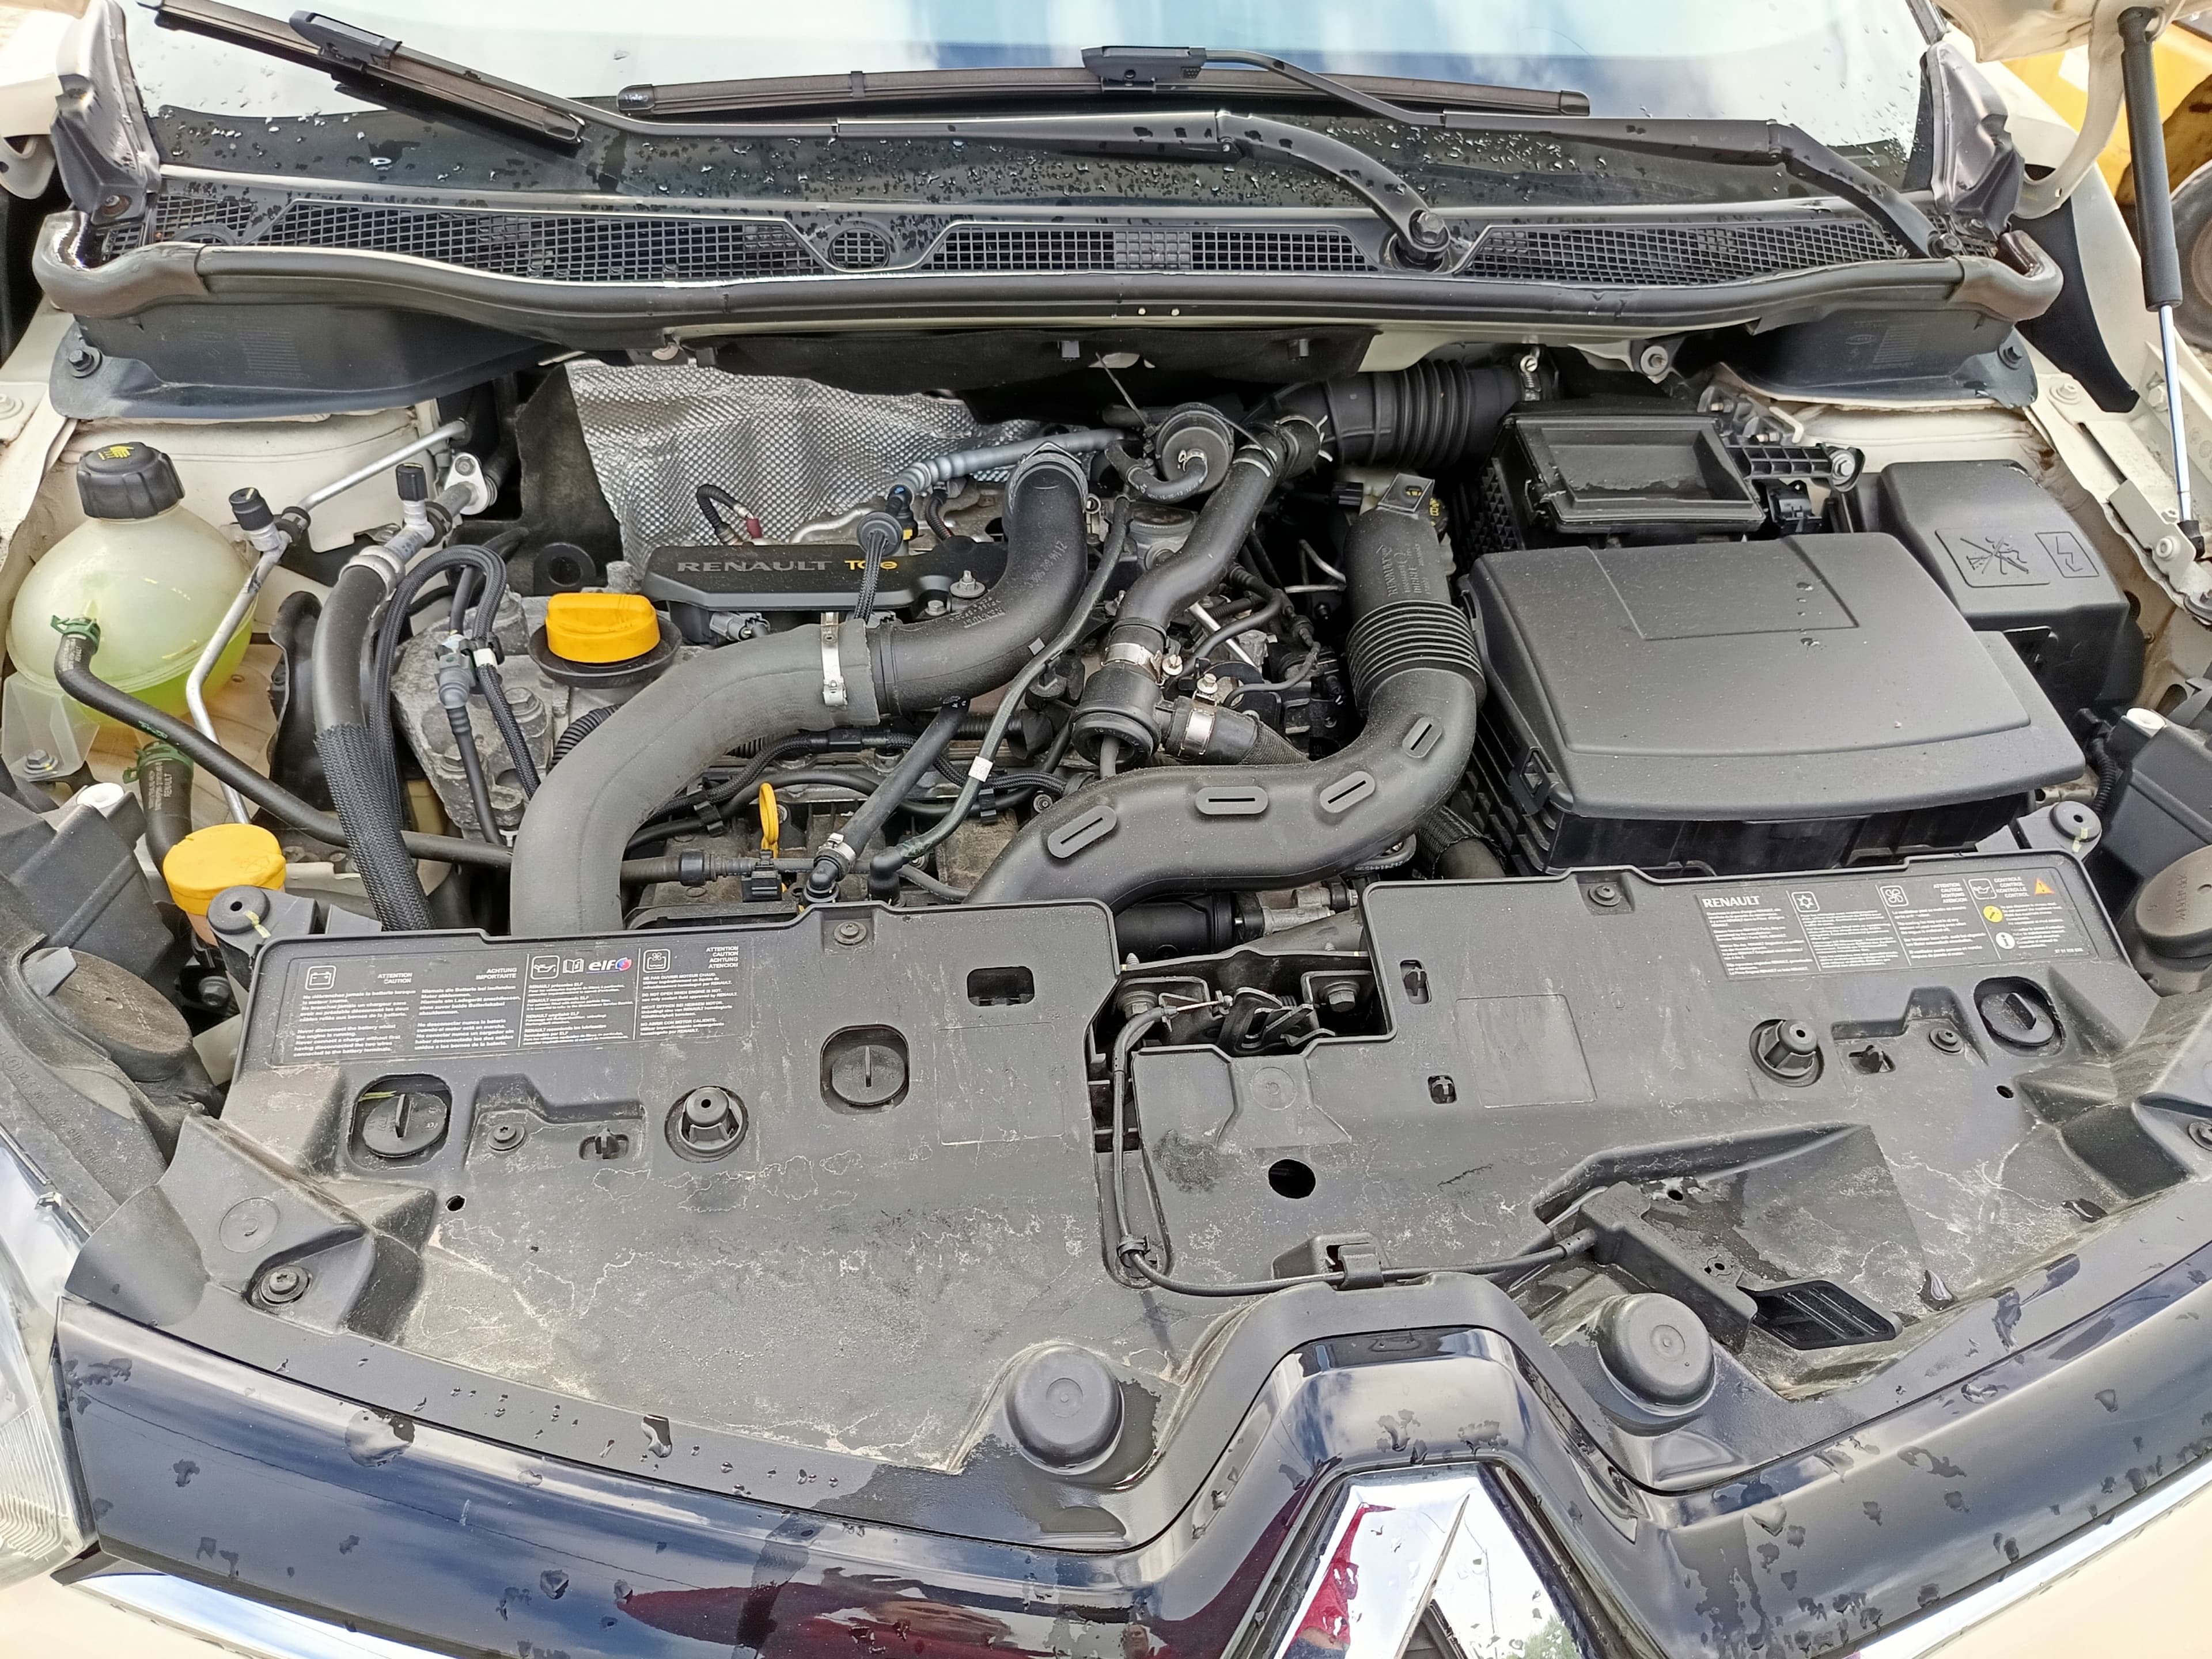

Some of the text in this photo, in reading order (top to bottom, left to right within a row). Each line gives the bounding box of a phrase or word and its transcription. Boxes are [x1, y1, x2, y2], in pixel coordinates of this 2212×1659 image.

[677, 560, 832, 572] RENAULT
[1702, 895, 1760, 908] RENAULT
[588, 960, 616, 971] elf
